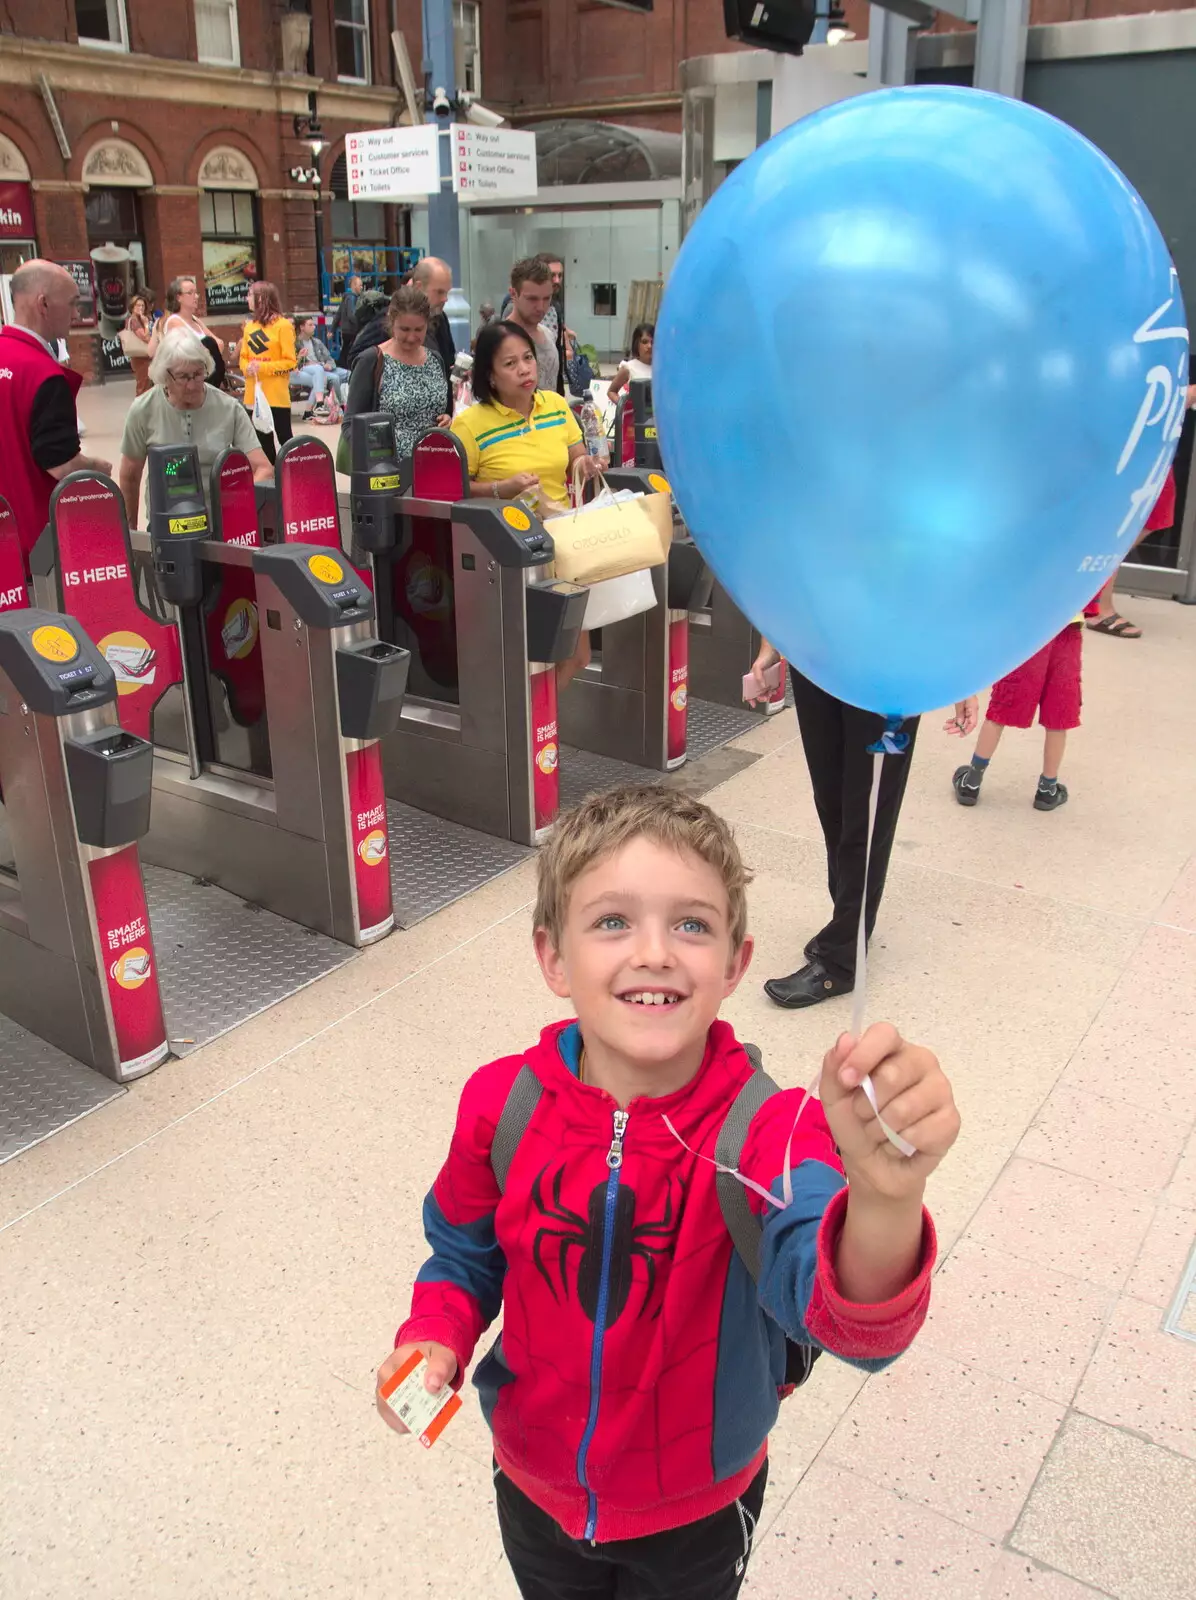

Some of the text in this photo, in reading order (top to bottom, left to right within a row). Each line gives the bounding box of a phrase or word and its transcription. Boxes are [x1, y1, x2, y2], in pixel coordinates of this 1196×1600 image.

[367, 136, 394, 147] Way out
[475, 132, 500, 143] Way out
[368, 149, 429, 161] Customer services
[476, 148, 531, 161] Customer services
[369, 166, 410, 176] Ticket Office
[477, 163, 515, 174] Ticket Office
[370, 184, 391, 192] Toilets
[478, 179, 497, 188] Toilets
[233, 282, 249, 292] mad
[60, 492, 114, 504] abellio greateranglia
[286, 516, 335, 535] IS HERE
[227, 530, 257, 546] SMART
[64, 564, 128, 586] IS HERE
[59, 670, 77, 680] TICKET
[672, 664, 688, 676] SMART
[537, 720, 556, 735] SMART
[537, 727, 557, 742] IS HERE
[357, 804, 382, 822] SMART
[358, 811, 385, 831] IS HERE
[107, 917, 142, 940] SMART
[108, 925, 146, 950] IS HERE
